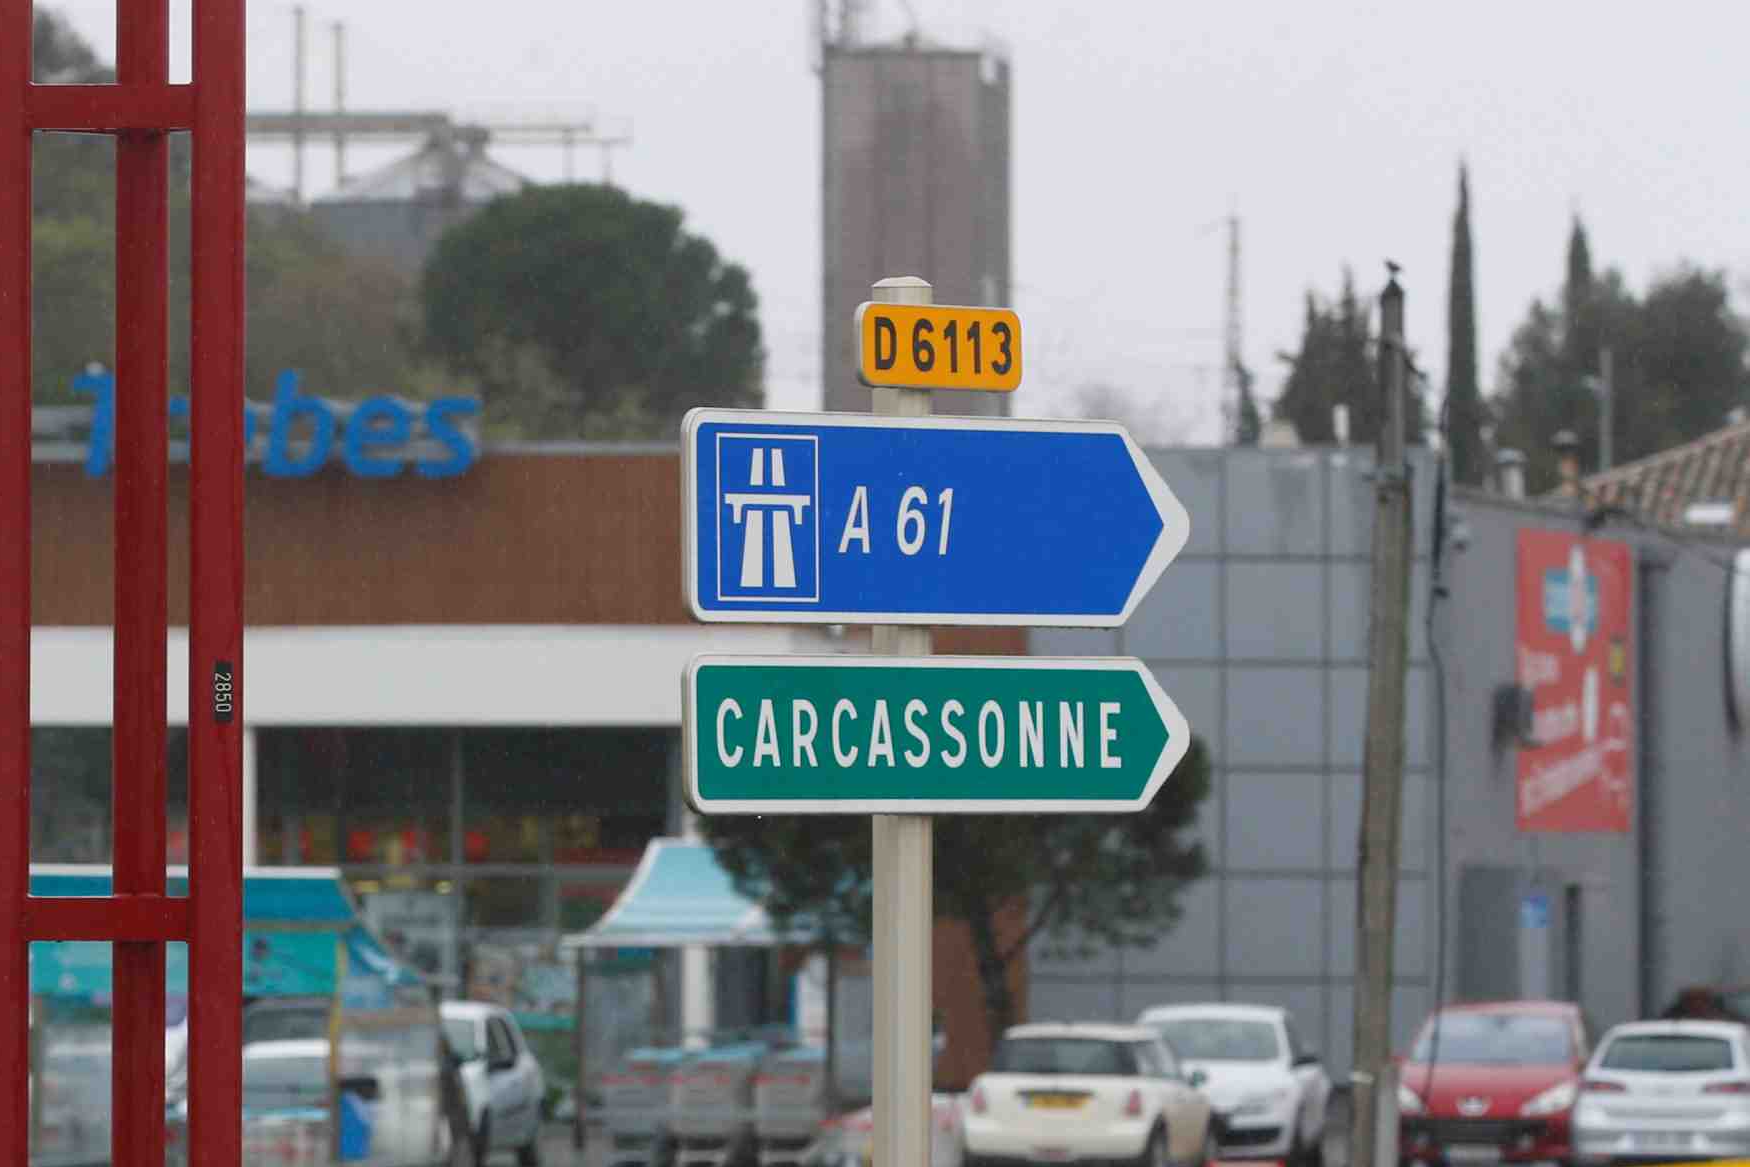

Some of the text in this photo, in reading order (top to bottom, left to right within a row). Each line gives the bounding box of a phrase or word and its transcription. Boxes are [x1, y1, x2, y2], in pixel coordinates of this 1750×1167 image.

[874, 316, 1013, 376] D 6113
[838, 485, 954, 556] A 61
[214, 672, 233, 712] 2850
[716, 698, 1122, 768] CARCASSONNE
